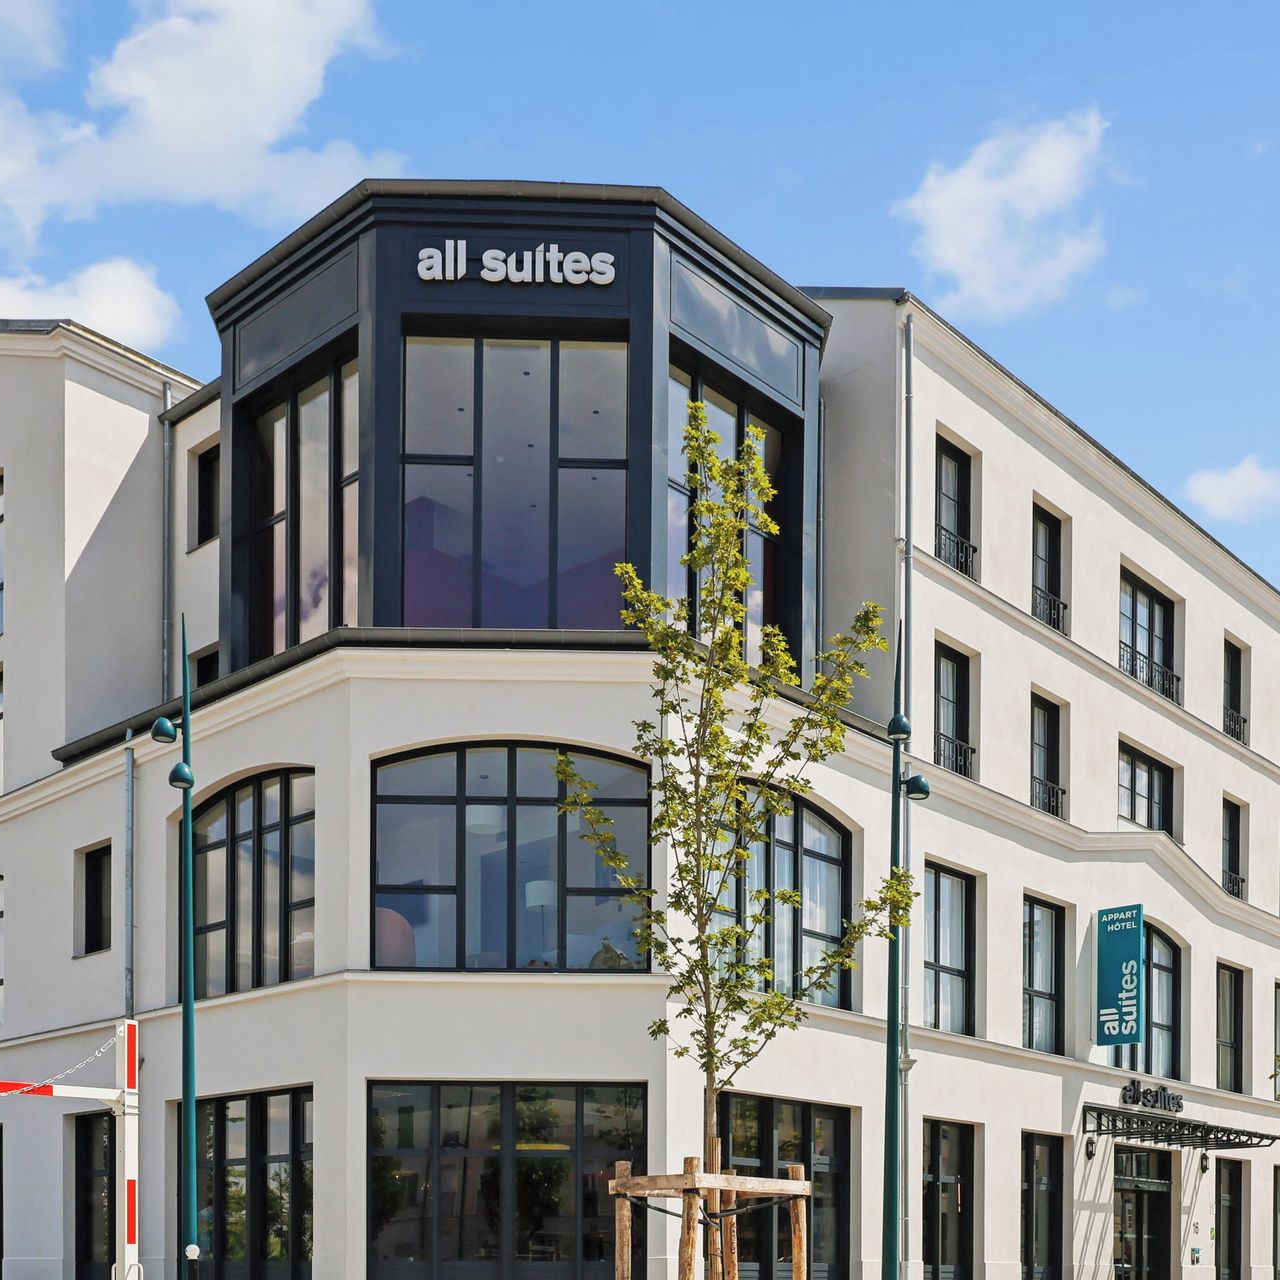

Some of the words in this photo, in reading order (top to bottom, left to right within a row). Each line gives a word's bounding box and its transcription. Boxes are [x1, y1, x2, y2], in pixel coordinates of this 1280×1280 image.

[417, 239, 467, 281] all
[480, 242, 616, 286] suites
[1101, 910, 1138, 923] APPART
[1107, 921, 1138, 932] HÔTEL
[1117, 959, 1138, 1036] suites
[1099, 1008, 1120, 1036] all
[1122, 1079, 1141, 1105] all
[1141, 1085, 1184, 1113] suites
